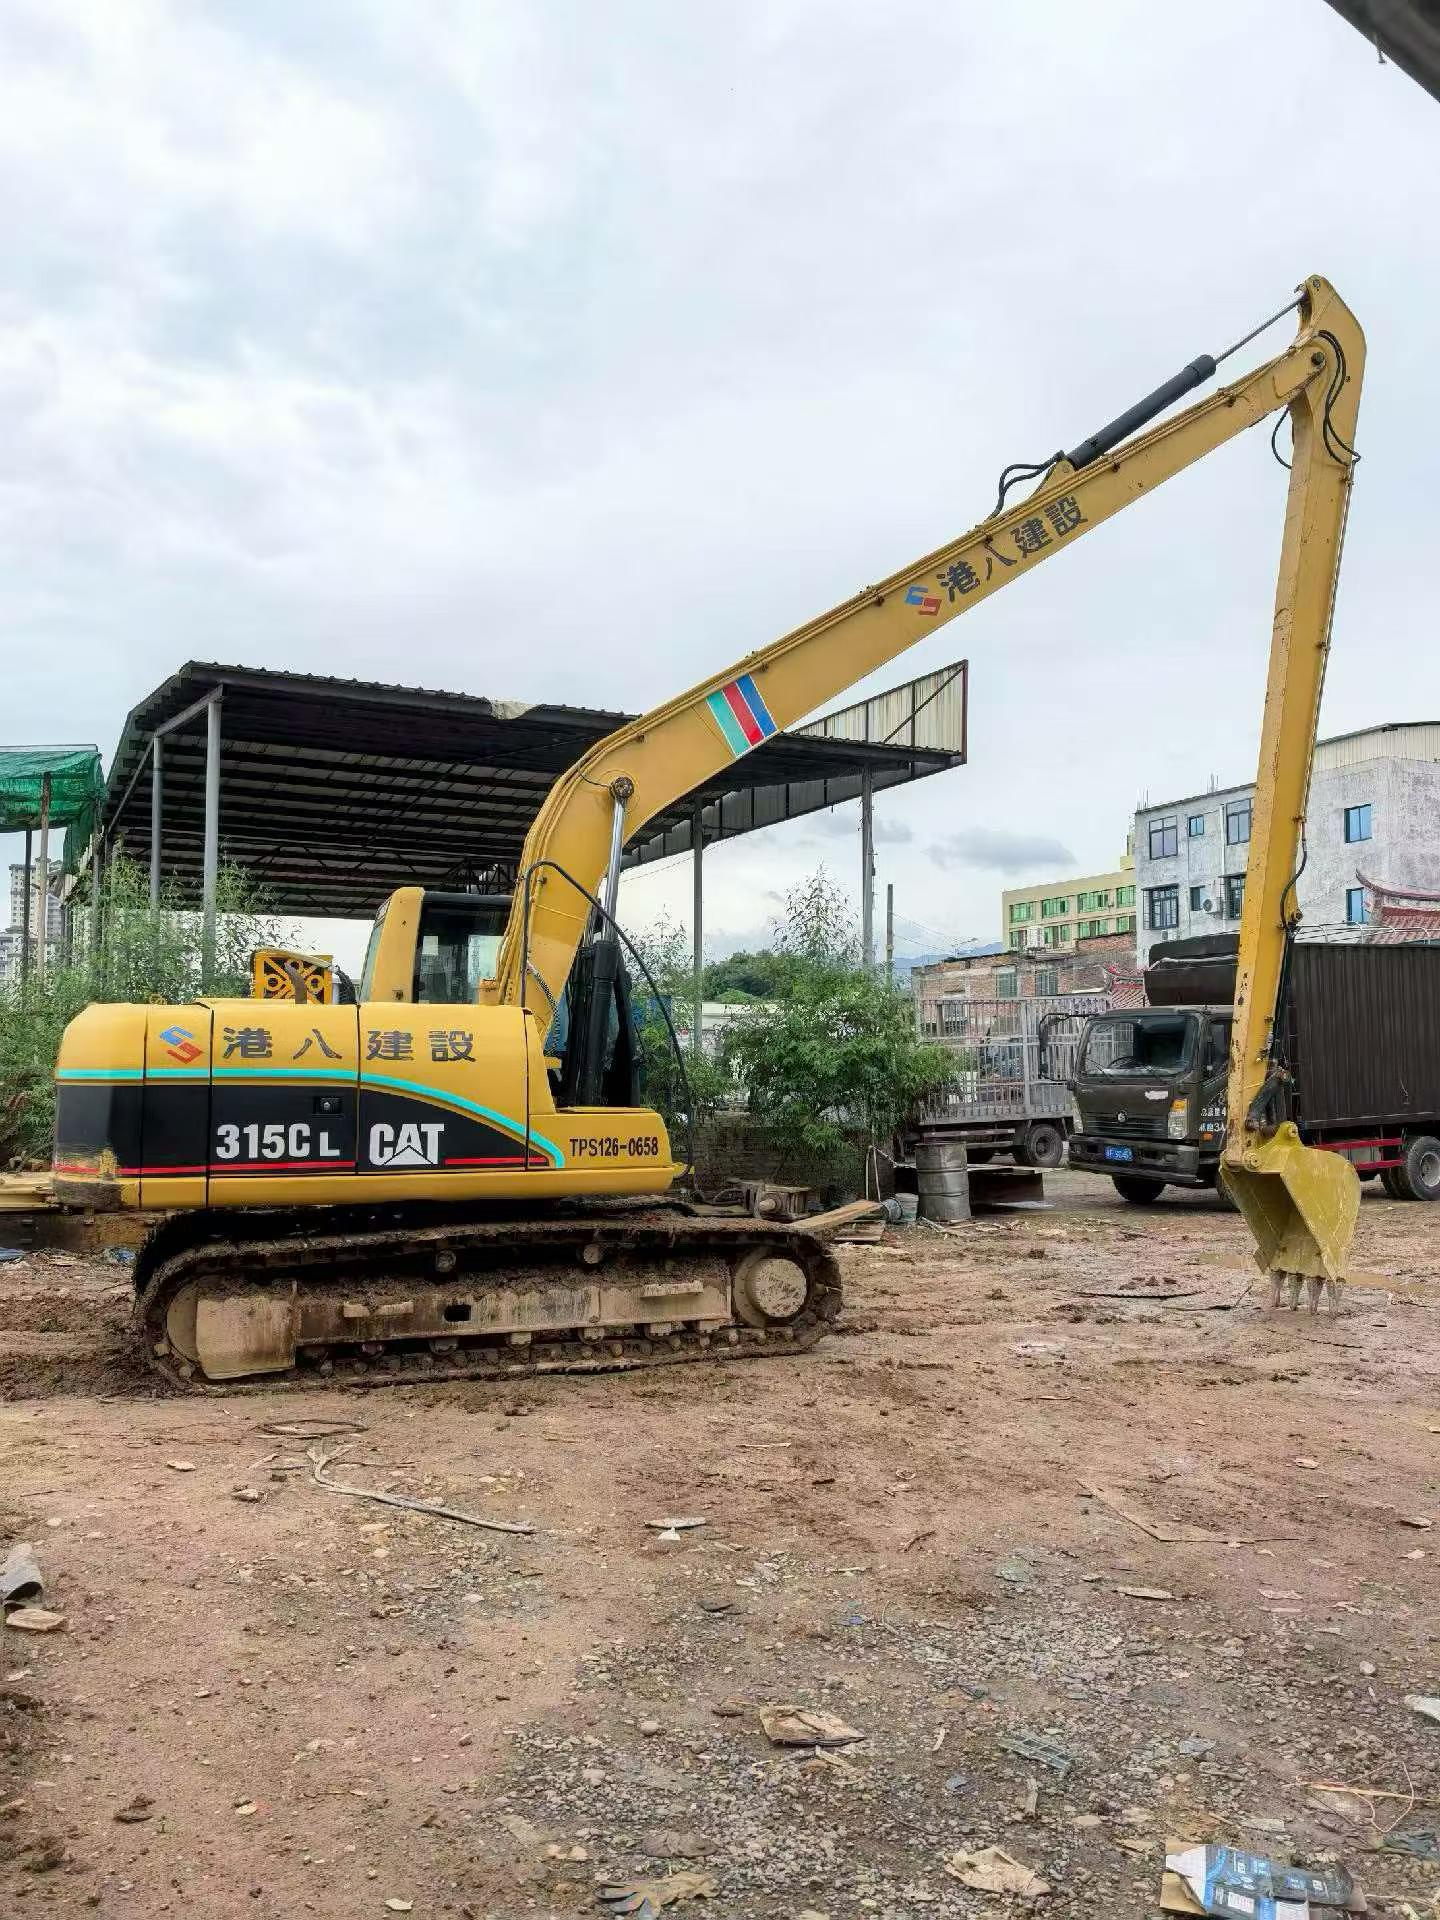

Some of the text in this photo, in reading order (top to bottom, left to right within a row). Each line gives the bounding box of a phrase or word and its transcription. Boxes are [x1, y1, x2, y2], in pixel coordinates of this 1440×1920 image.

[936, 496, 1088, 603] 港八建設
[222, 1027, 477, 1061] 港八建設
[215, 1123, 341, 1159] 315C L
[368, 1123, 445, 1166] CAT
[569, 1136, 659, 1157] TPS126-0658
